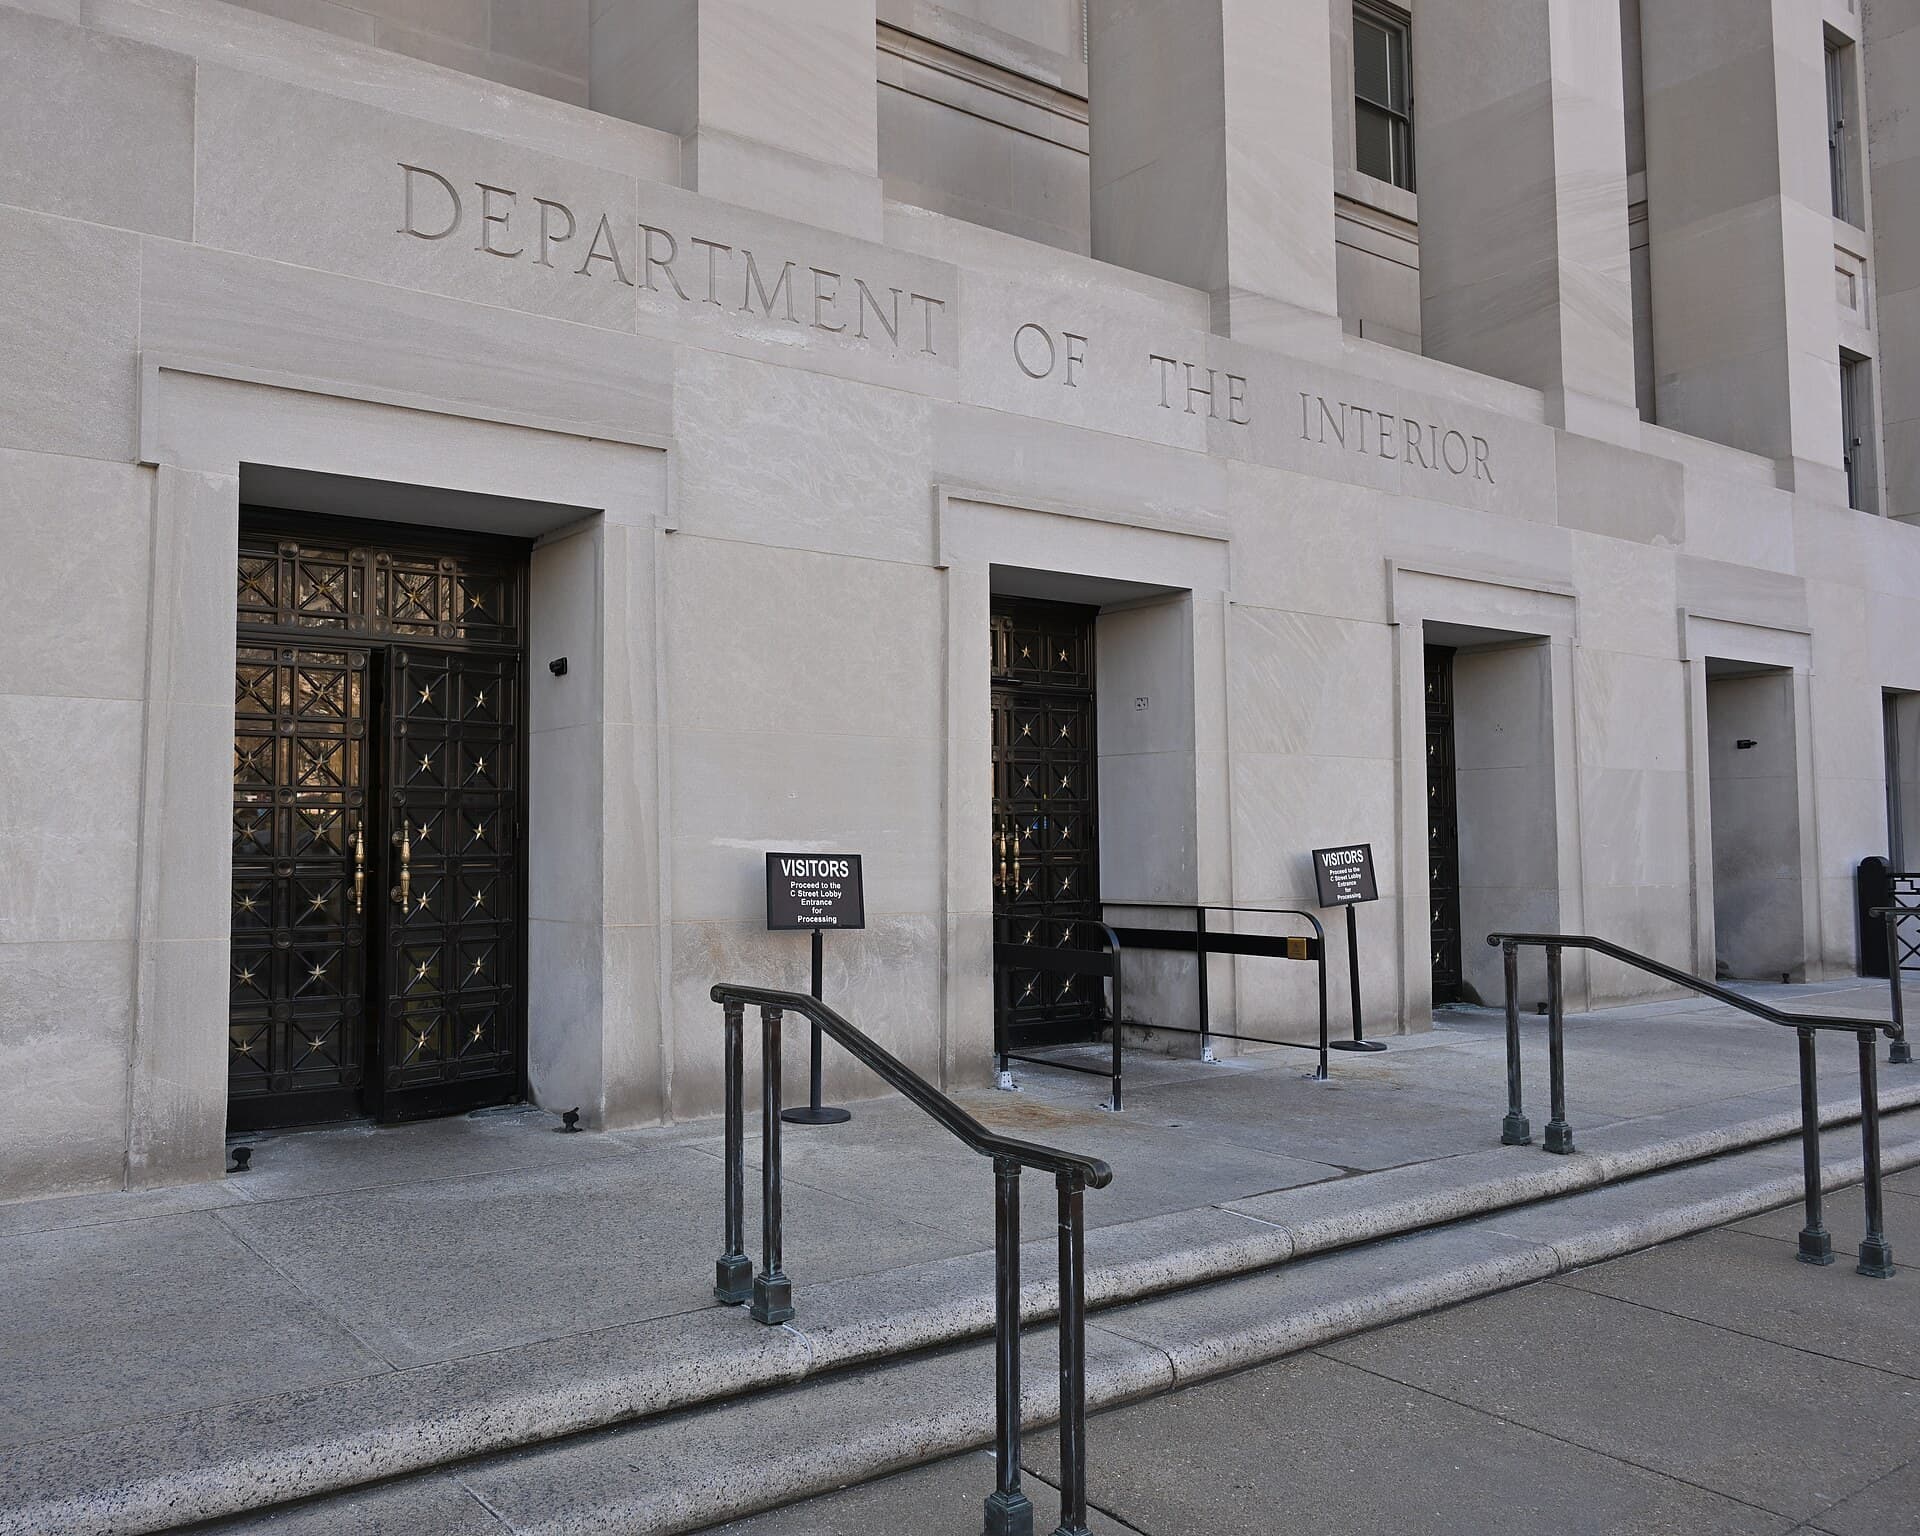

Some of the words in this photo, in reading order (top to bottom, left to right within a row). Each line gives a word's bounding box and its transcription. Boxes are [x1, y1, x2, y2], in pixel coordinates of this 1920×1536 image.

[397, 162, 946, 356] DEPARTMENT
[1013, 322, 1089, 388] OF
[1149, 353, 1252, 426] THE
[1299, 391, 1497, 485] INTERIOR
[1322, 850, 1363, 866] VISITORS
[781, 859, 849, 877] VISITORS
[790, 881, 820, 889] Proceed
[797, 890, 819, 898] Street
[820, 890, 842, 899] Lobby
[797, 915, 837, 924] Processing
